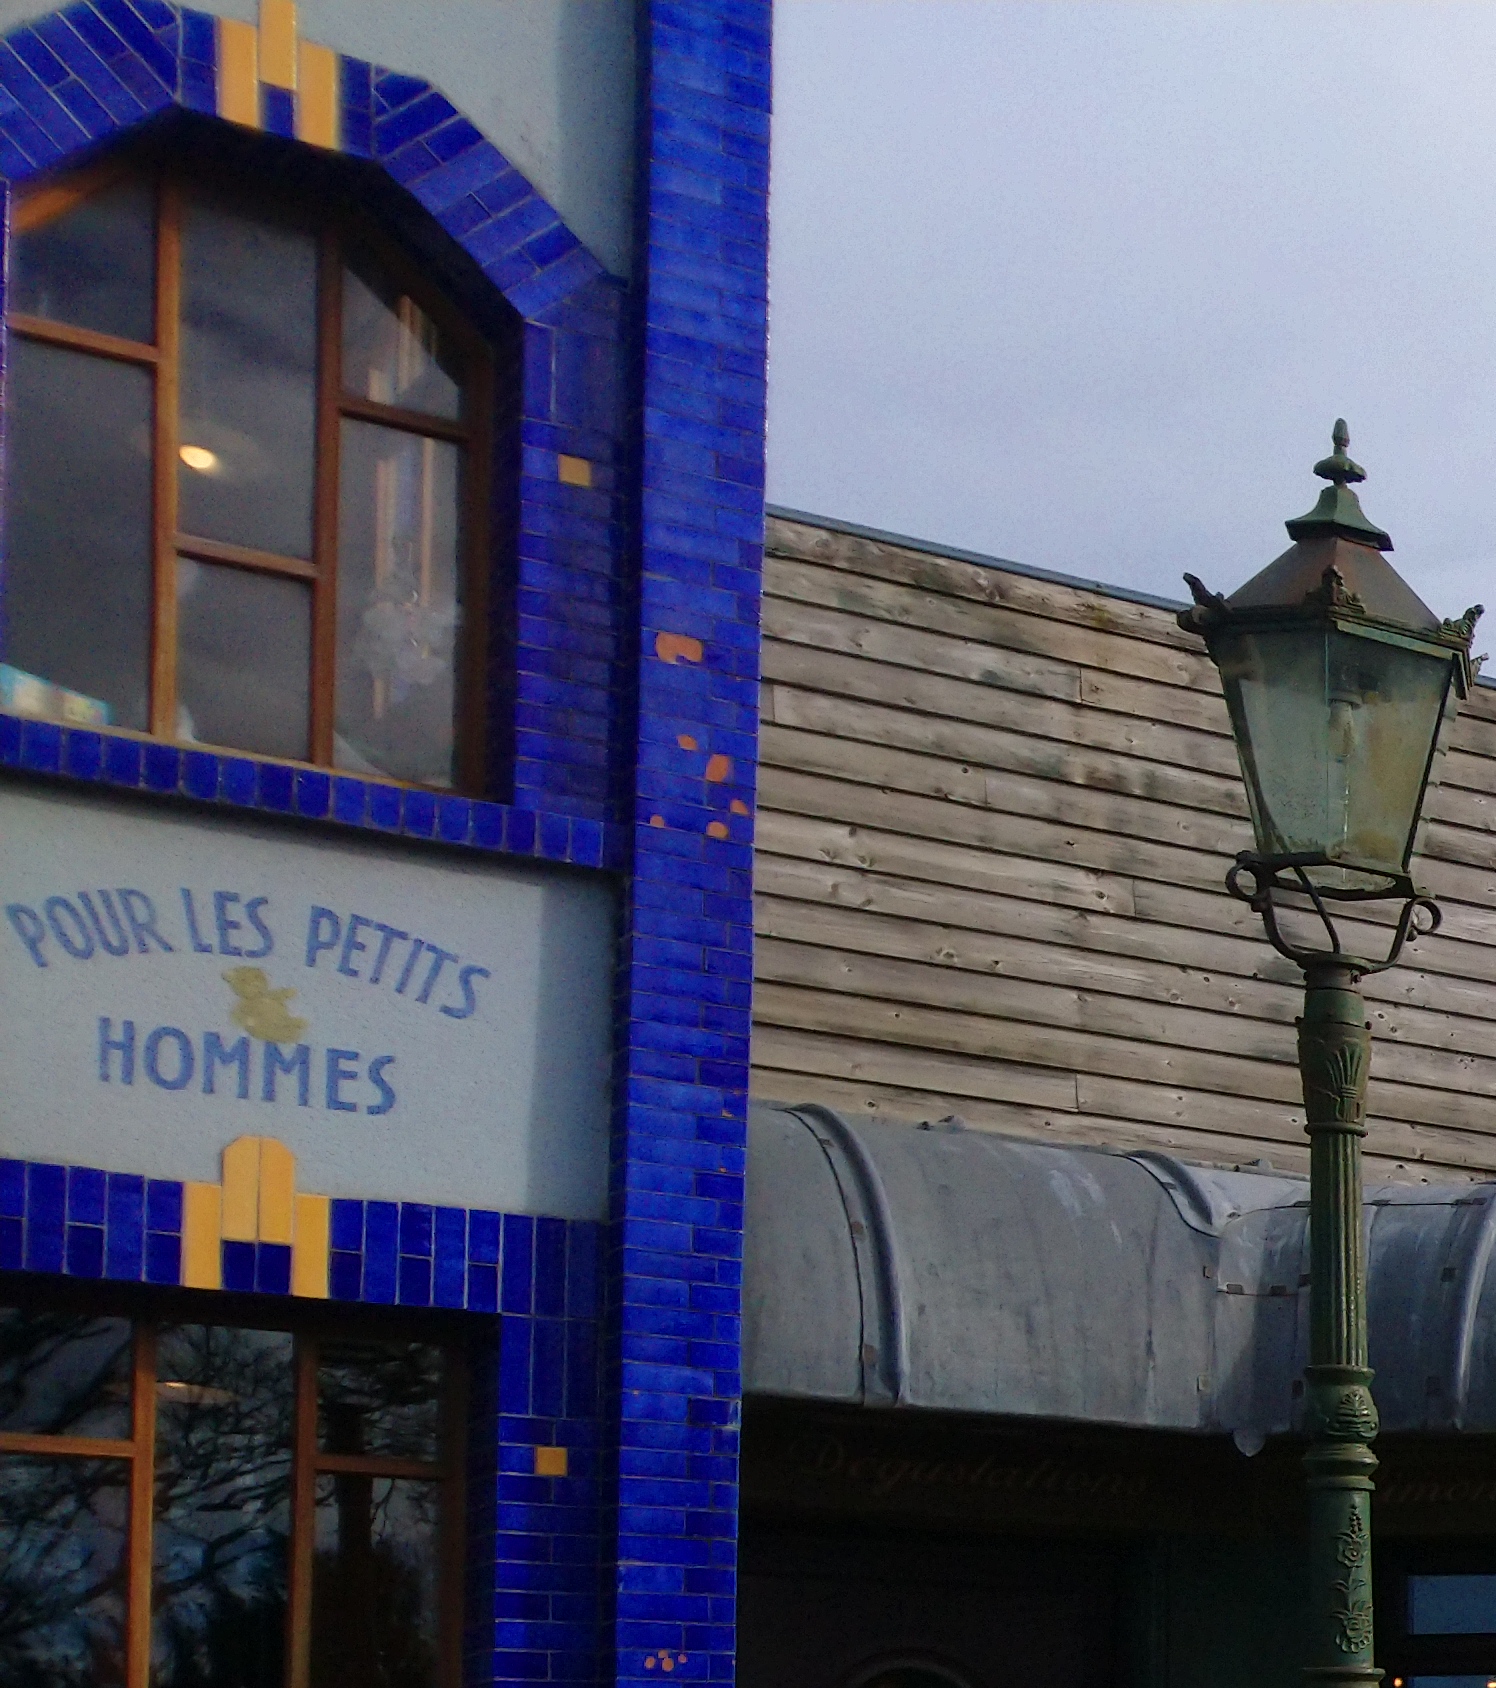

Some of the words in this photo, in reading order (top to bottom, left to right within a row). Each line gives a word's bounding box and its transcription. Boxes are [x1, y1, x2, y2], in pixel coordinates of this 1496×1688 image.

[6, 888, 174, 968] POUR
[181, 887, 275, 959] LES
[305, 905, 493, 1020] PETITS
[97, 1016, 398, 1115] HOMMES
